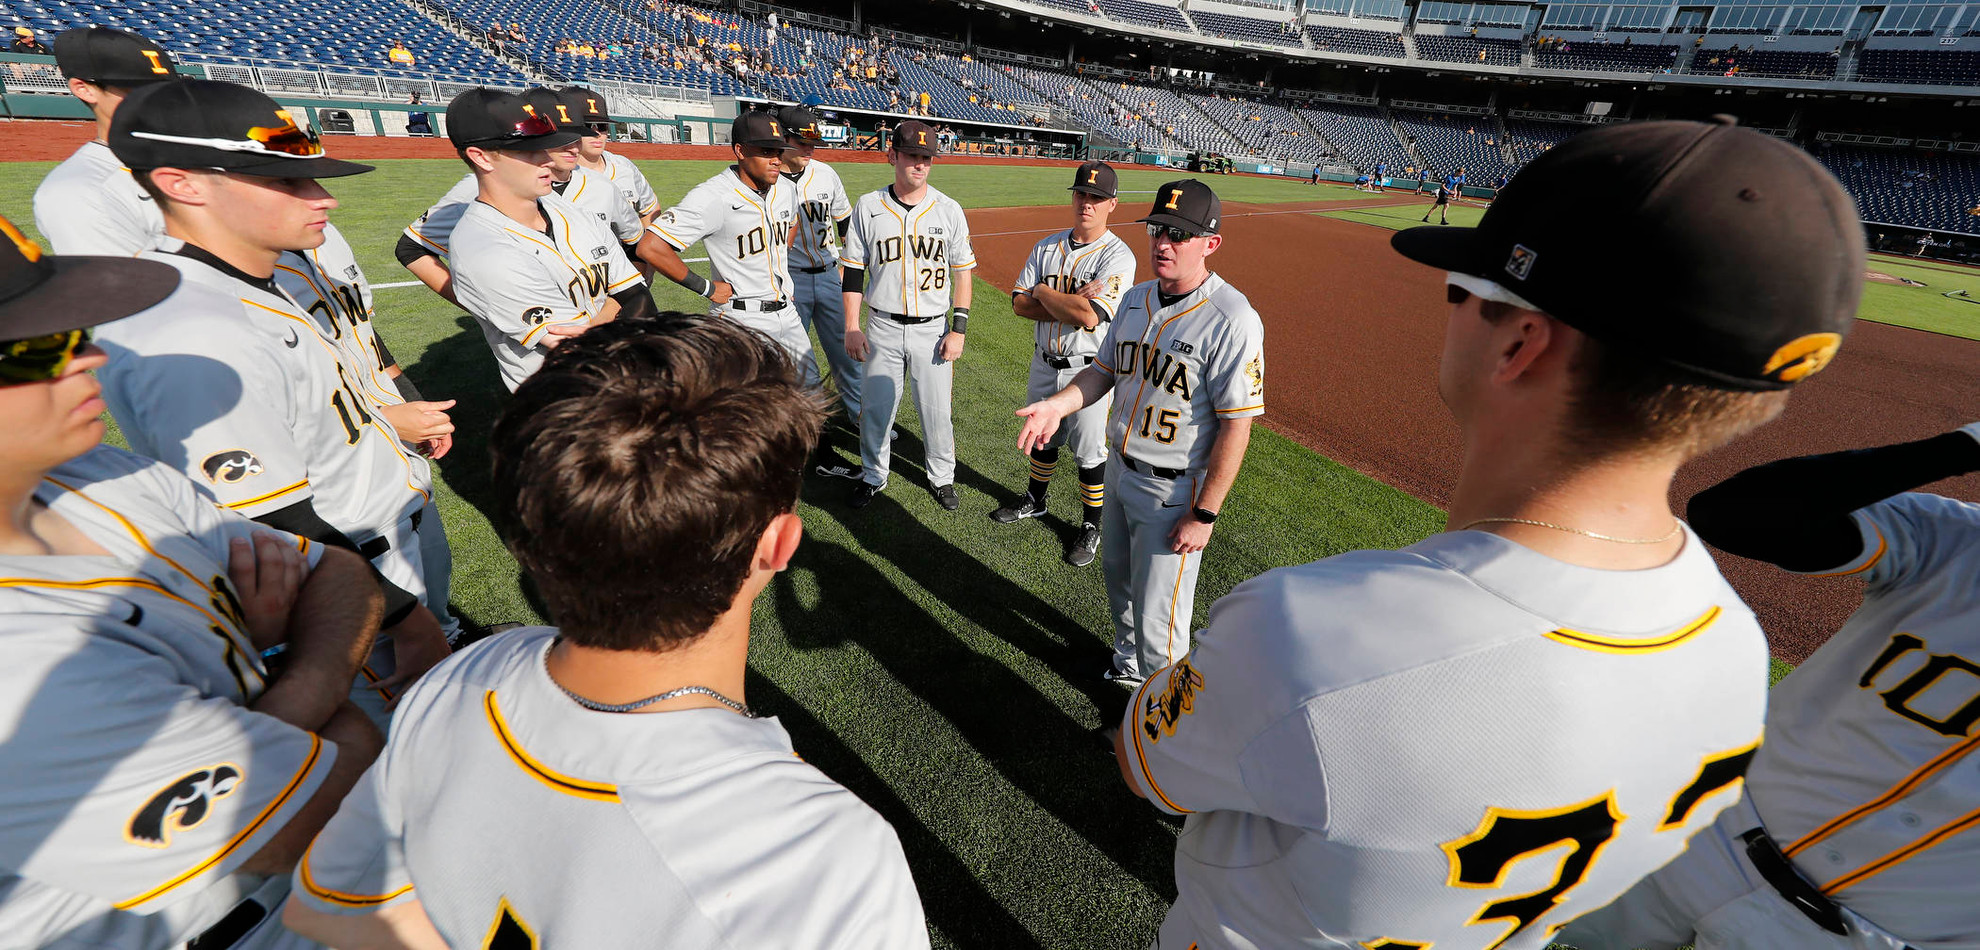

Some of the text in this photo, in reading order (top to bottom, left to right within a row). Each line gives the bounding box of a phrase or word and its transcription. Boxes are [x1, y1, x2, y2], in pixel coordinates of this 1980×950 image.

[141, 50, 169, 74] I
[555, 105, 572, 123] I
[586, 99, 599, 114] I
[769, 122, 780, 137] I
[918, 131, 927, 146] I
[1087, 170, 1099, 184] I
[1165, 189, 1184, 210] I
[876, 235, 946, 265] IOWA
[920, 268, 945, 292] 28
[1140, 405, 1182, 445] 15
[831, 465, 851, 476] NIKE
